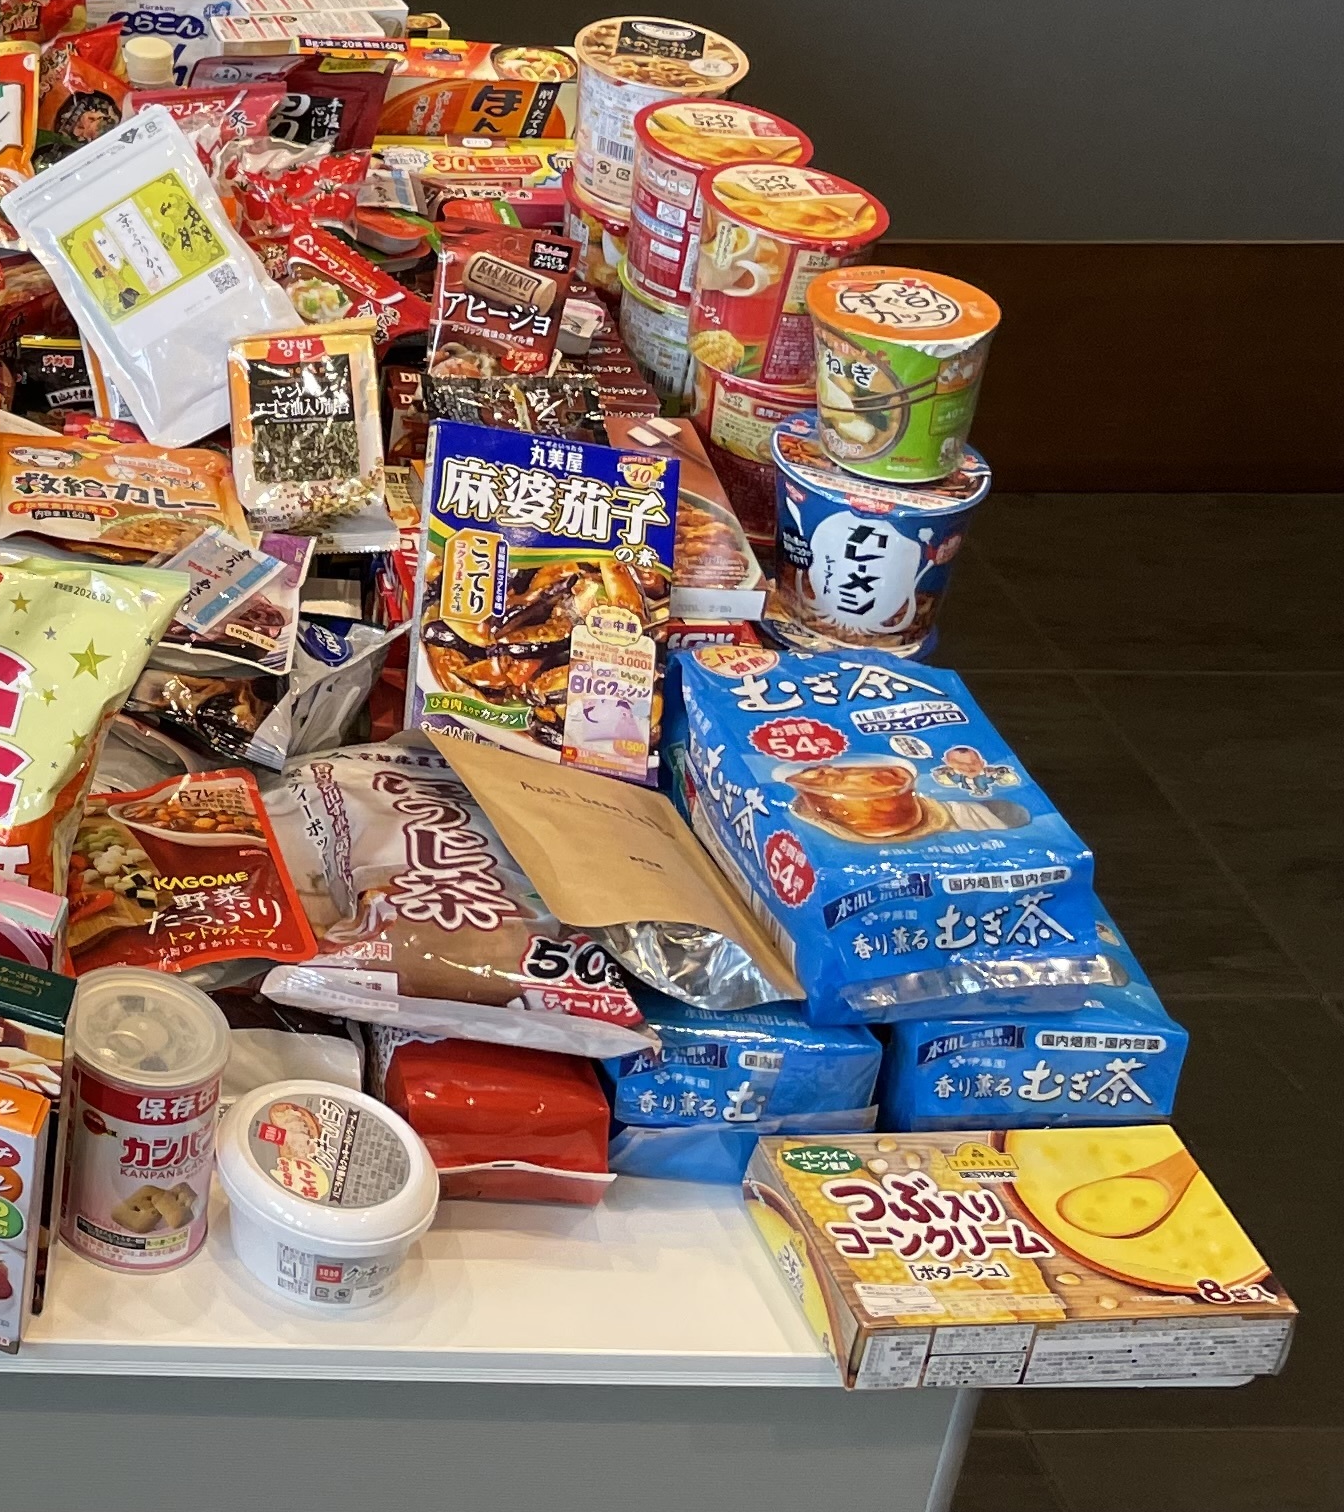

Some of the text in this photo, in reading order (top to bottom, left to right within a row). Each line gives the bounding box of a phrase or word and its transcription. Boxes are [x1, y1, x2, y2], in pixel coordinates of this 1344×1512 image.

[152, 100, 226, 117] アマノフーズ
[442, 290, 551, 339] アヒージョ
[873, 298, 959, 326] カップ
[824, 352, 875, 387] ねぎ
[529, 447, 584, 474] 丸美屋
[441, 456, 667, 547] 麻婆茄子
[466, 535, 491, 615] こってり
[837, 523, 891, 616] カレーメシ
[736, 660, 948, 713] むぎ茶
[770, 736, 818, 758] 54
[153, 870, 249, 892] KAGOME
[174, 885, 250, 911] 野菜
[167, 928, 276, 944] トマトのスープ
[852, 889, 1076, 959] 香り薫る むぎ茶
[933, 1060, 1153, 1107] 香り薫る むぎ茶
[951, 1156, 1014, 1170] TOPVALU
[831, 1177, 1001, 1224] つぶ入り
[831, 1222, 1053, 1260] コーンクリーム
